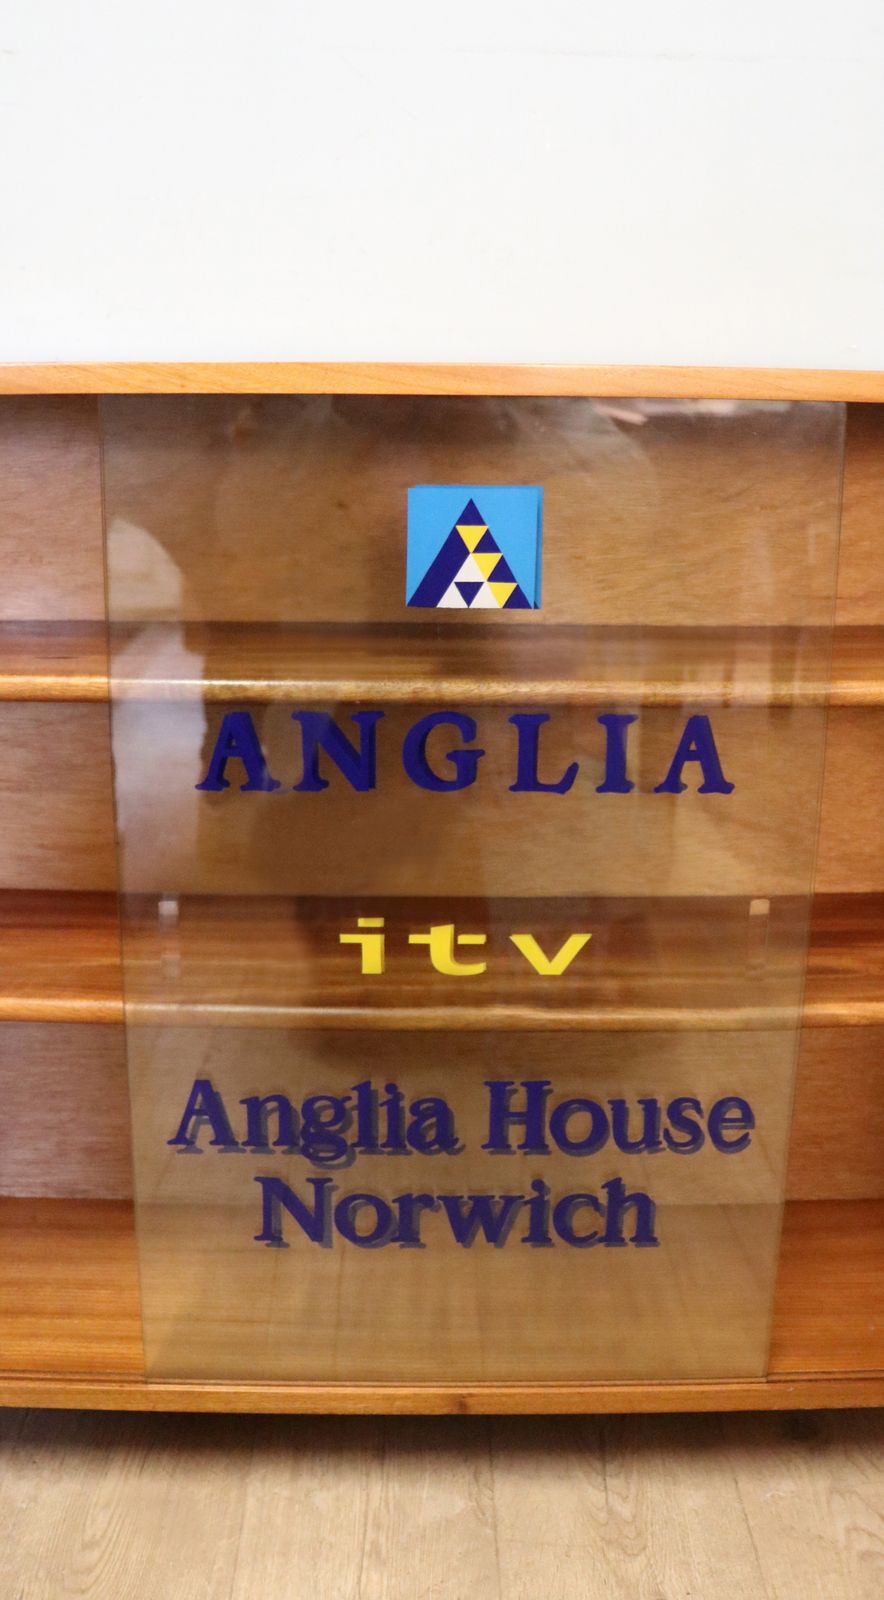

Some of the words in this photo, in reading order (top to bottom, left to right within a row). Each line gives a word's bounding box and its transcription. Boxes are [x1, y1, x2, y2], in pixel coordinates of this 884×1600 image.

[194, 710, 735, 794] ANGLIA
[339, 917, 592, 976] itv
[167, 1079, 460, 1162] Anglia
[482, 1080, 755, 1153] House
[254, 1176, 659, 1247] Norwich
